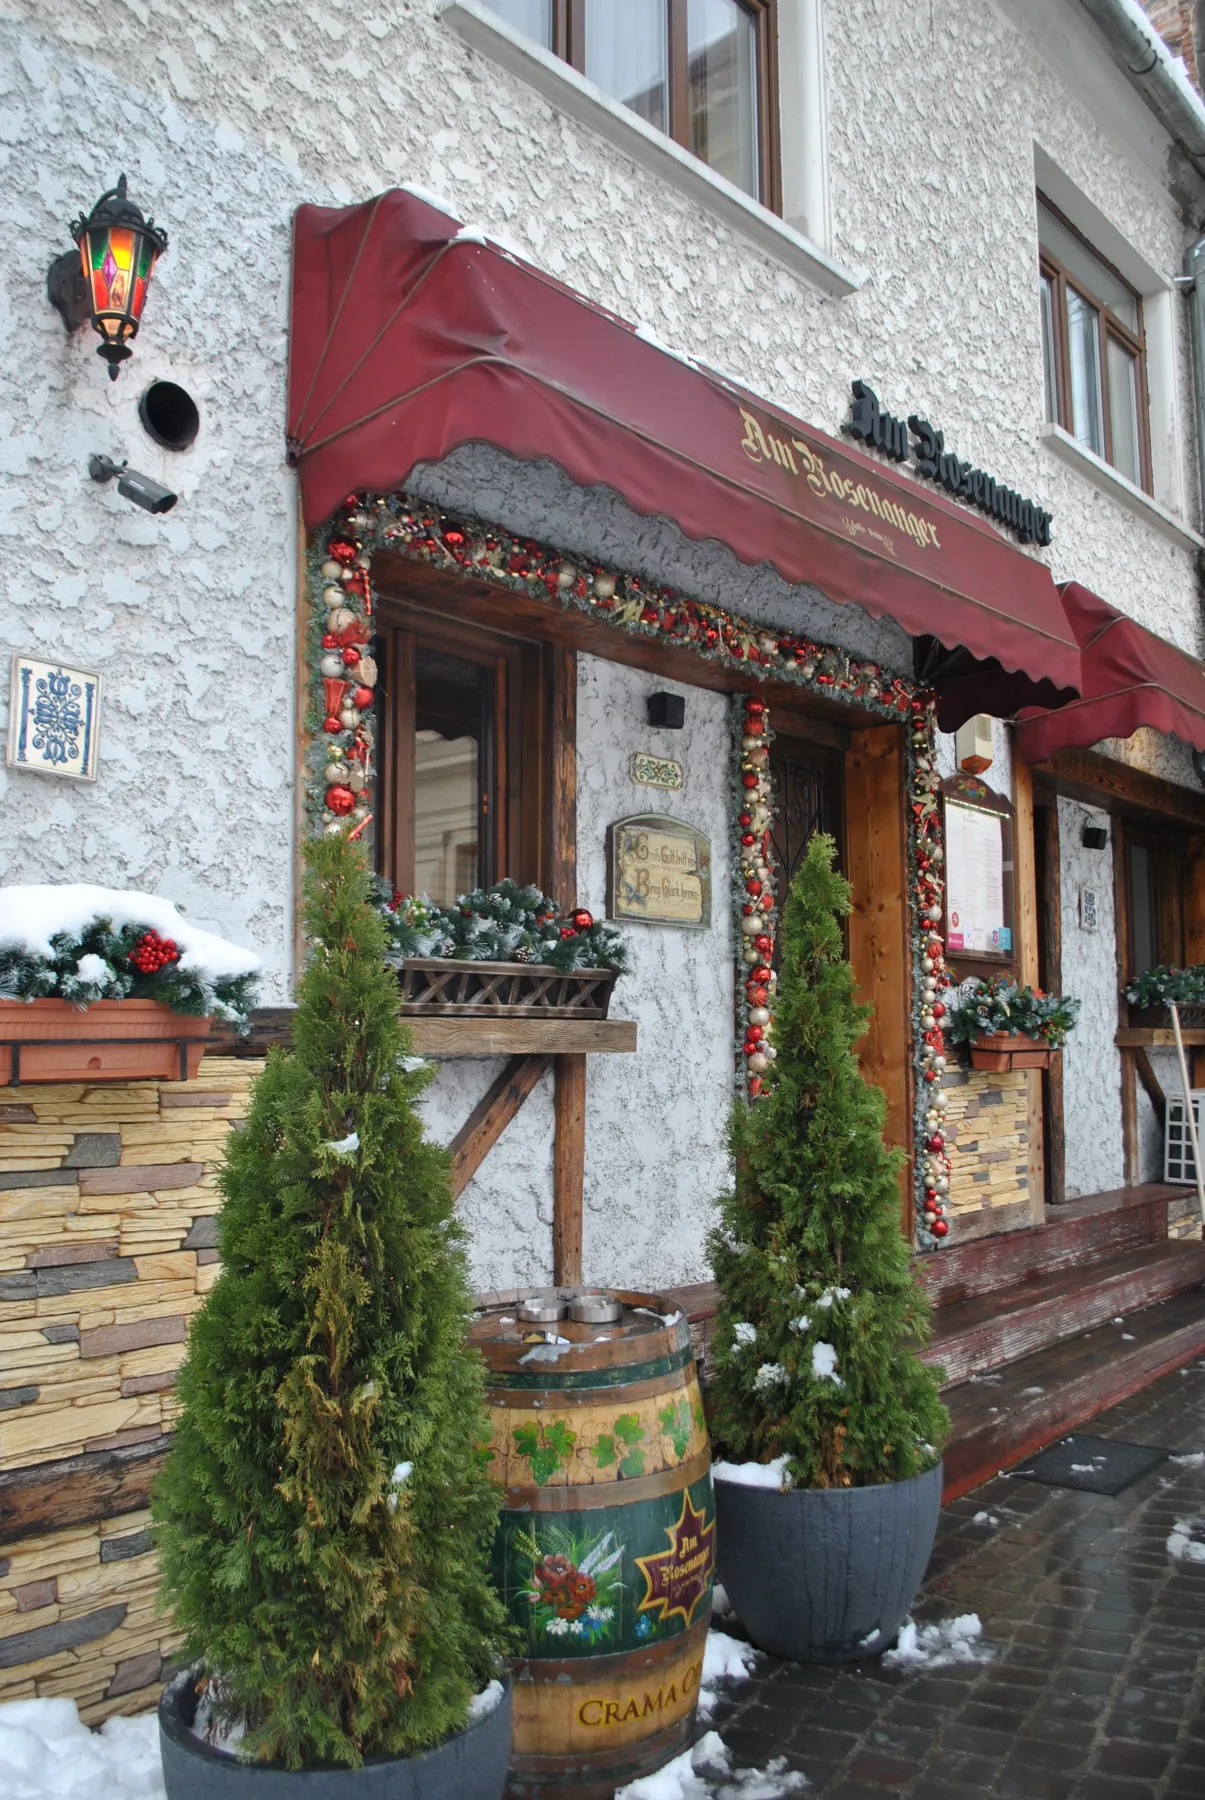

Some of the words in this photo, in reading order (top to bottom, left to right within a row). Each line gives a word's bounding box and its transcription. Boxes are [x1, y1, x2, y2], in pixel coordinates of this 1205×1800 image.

[740, 405, 799, 475] Am
[791, 436, 942, 550] Rosenanger
[840, 380, 908, 463] Am
[908, 415, 1053, 547] Rosenanger
[679, 1535, 698, 1558] Am
[578, 1683, 677, 1726] CRAMA
